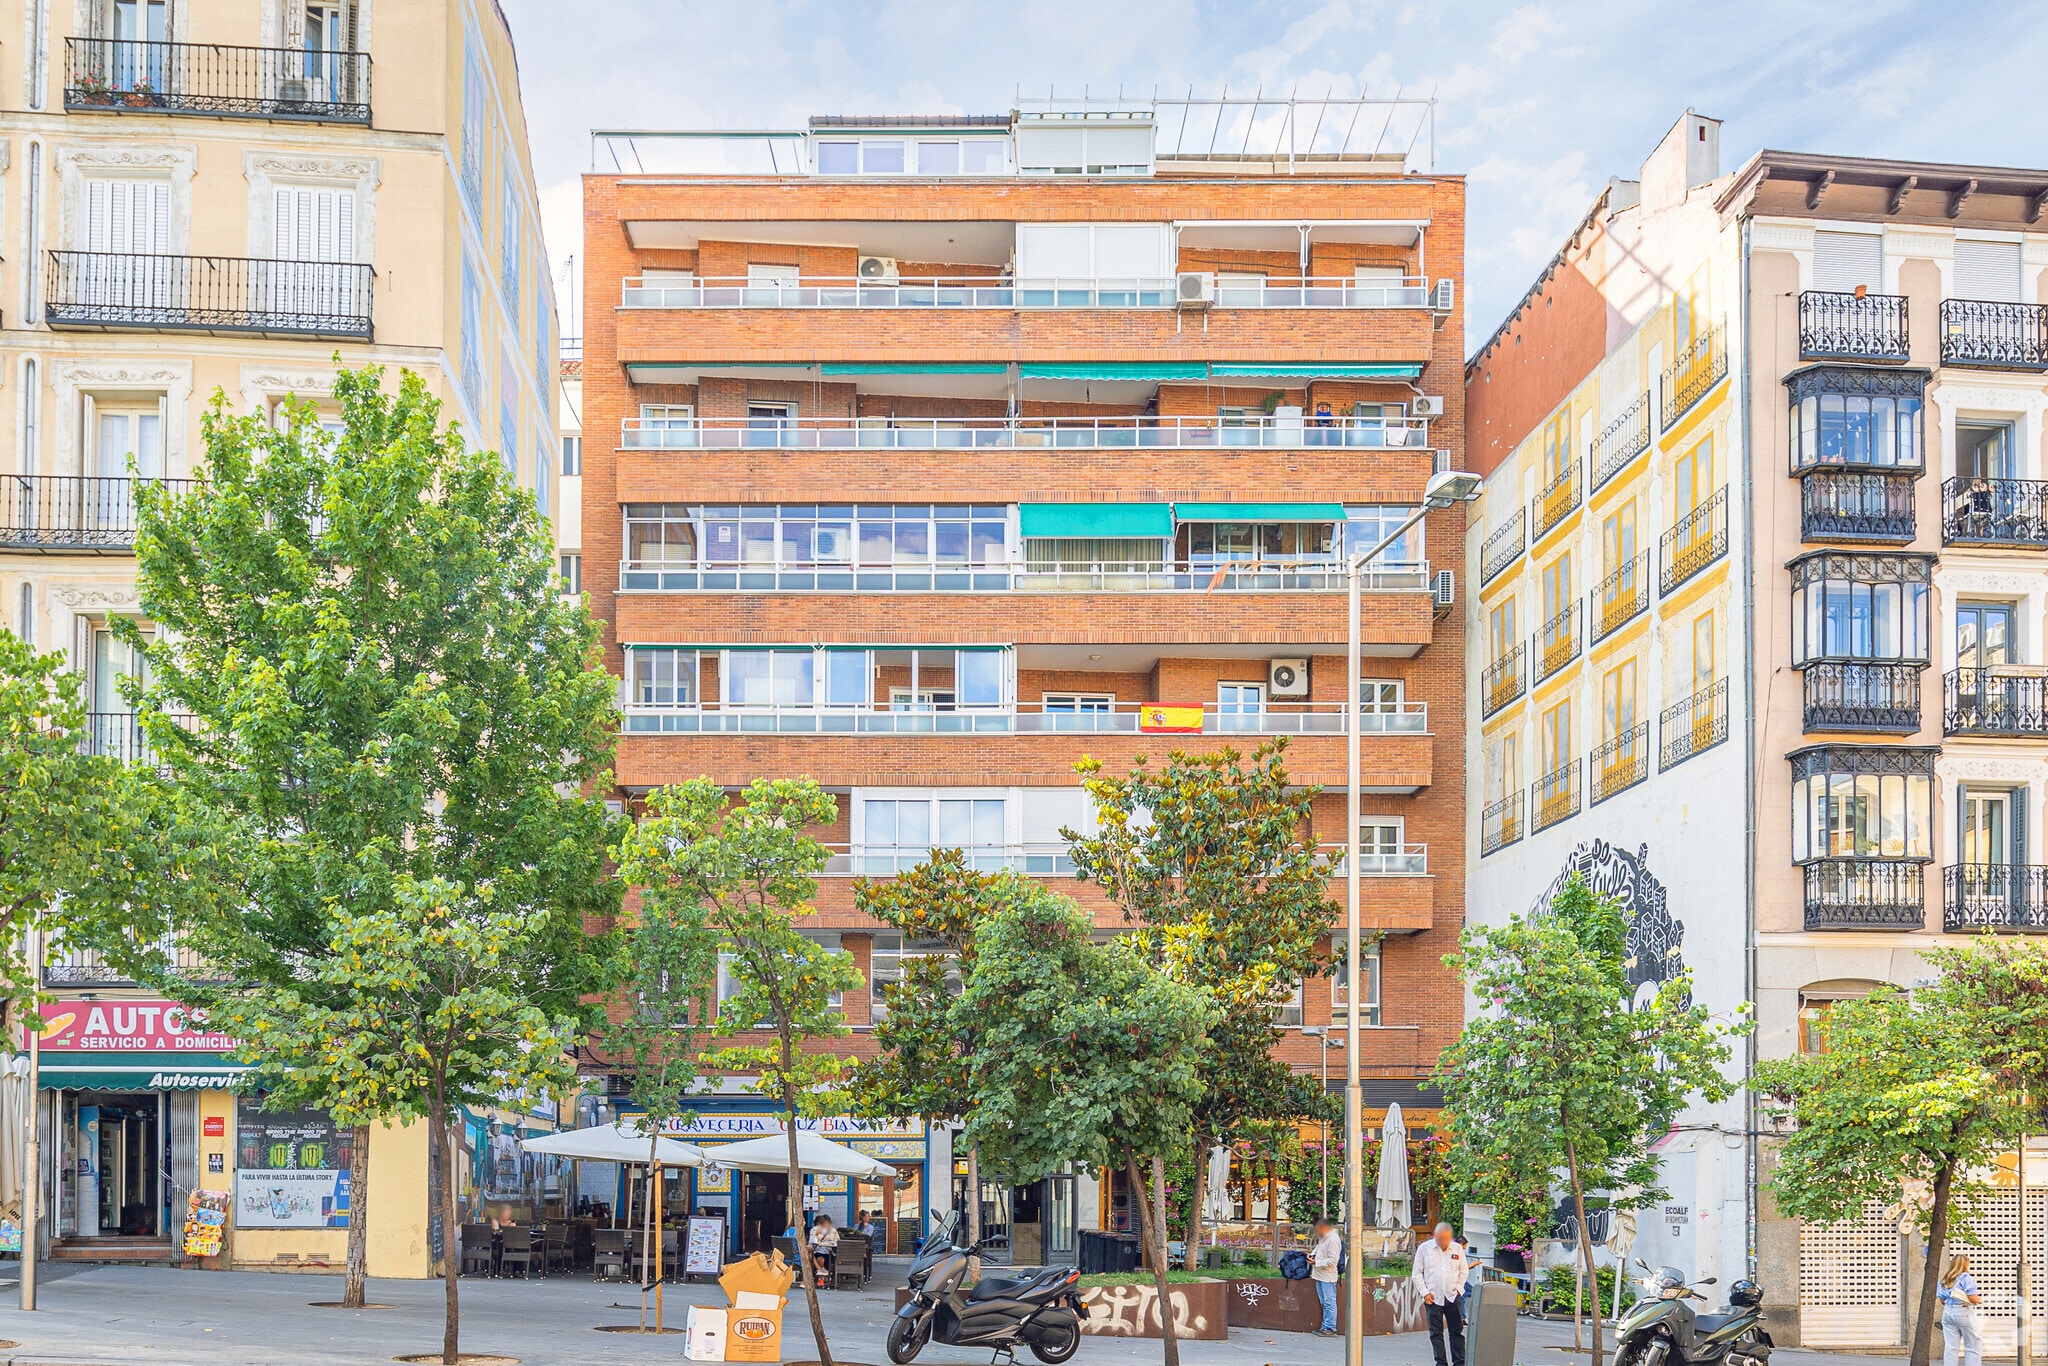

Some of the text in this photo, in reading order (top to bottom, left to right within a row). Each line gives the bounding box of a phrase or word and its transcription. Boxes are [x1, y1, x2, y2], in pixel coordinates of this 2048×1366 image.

[80, 1037, 147, 1049] SERVICIO
[155, 1037, 166, 1049] A
[779, 1118, 816, 1131] CUZ
[1665, 1206, 1688, 1214] ECOALF
[739, 1321, 770, 1336] RUIPAN
